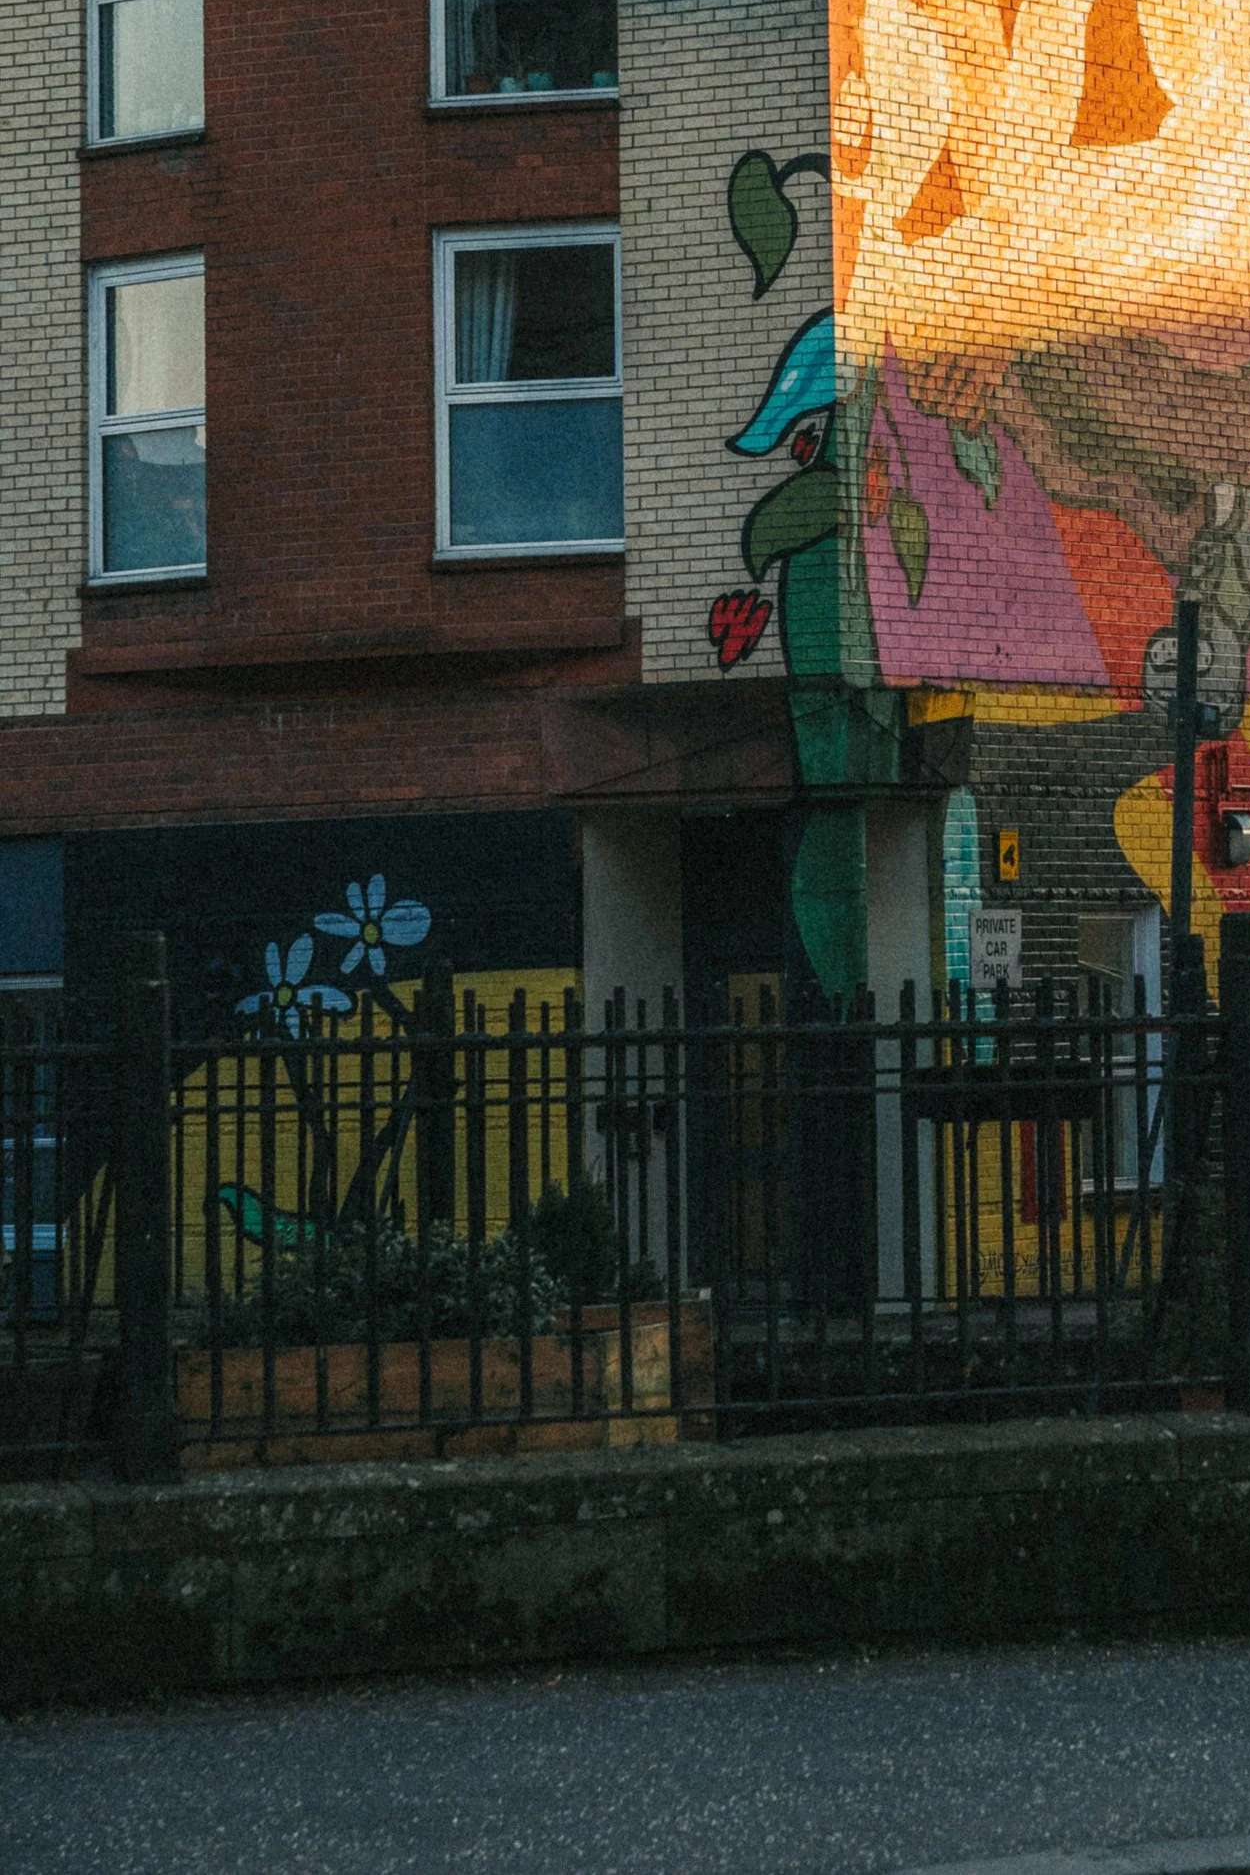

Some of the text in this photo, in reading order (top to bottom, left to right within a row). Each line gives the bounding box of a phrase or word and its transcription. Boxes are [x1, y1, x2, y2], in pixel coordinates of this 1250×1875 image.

[976, 918, 1016, 934] PRIVATE
[986, 941, 1008, 956] CAR
[983, 964, 1010, 980] PARK
